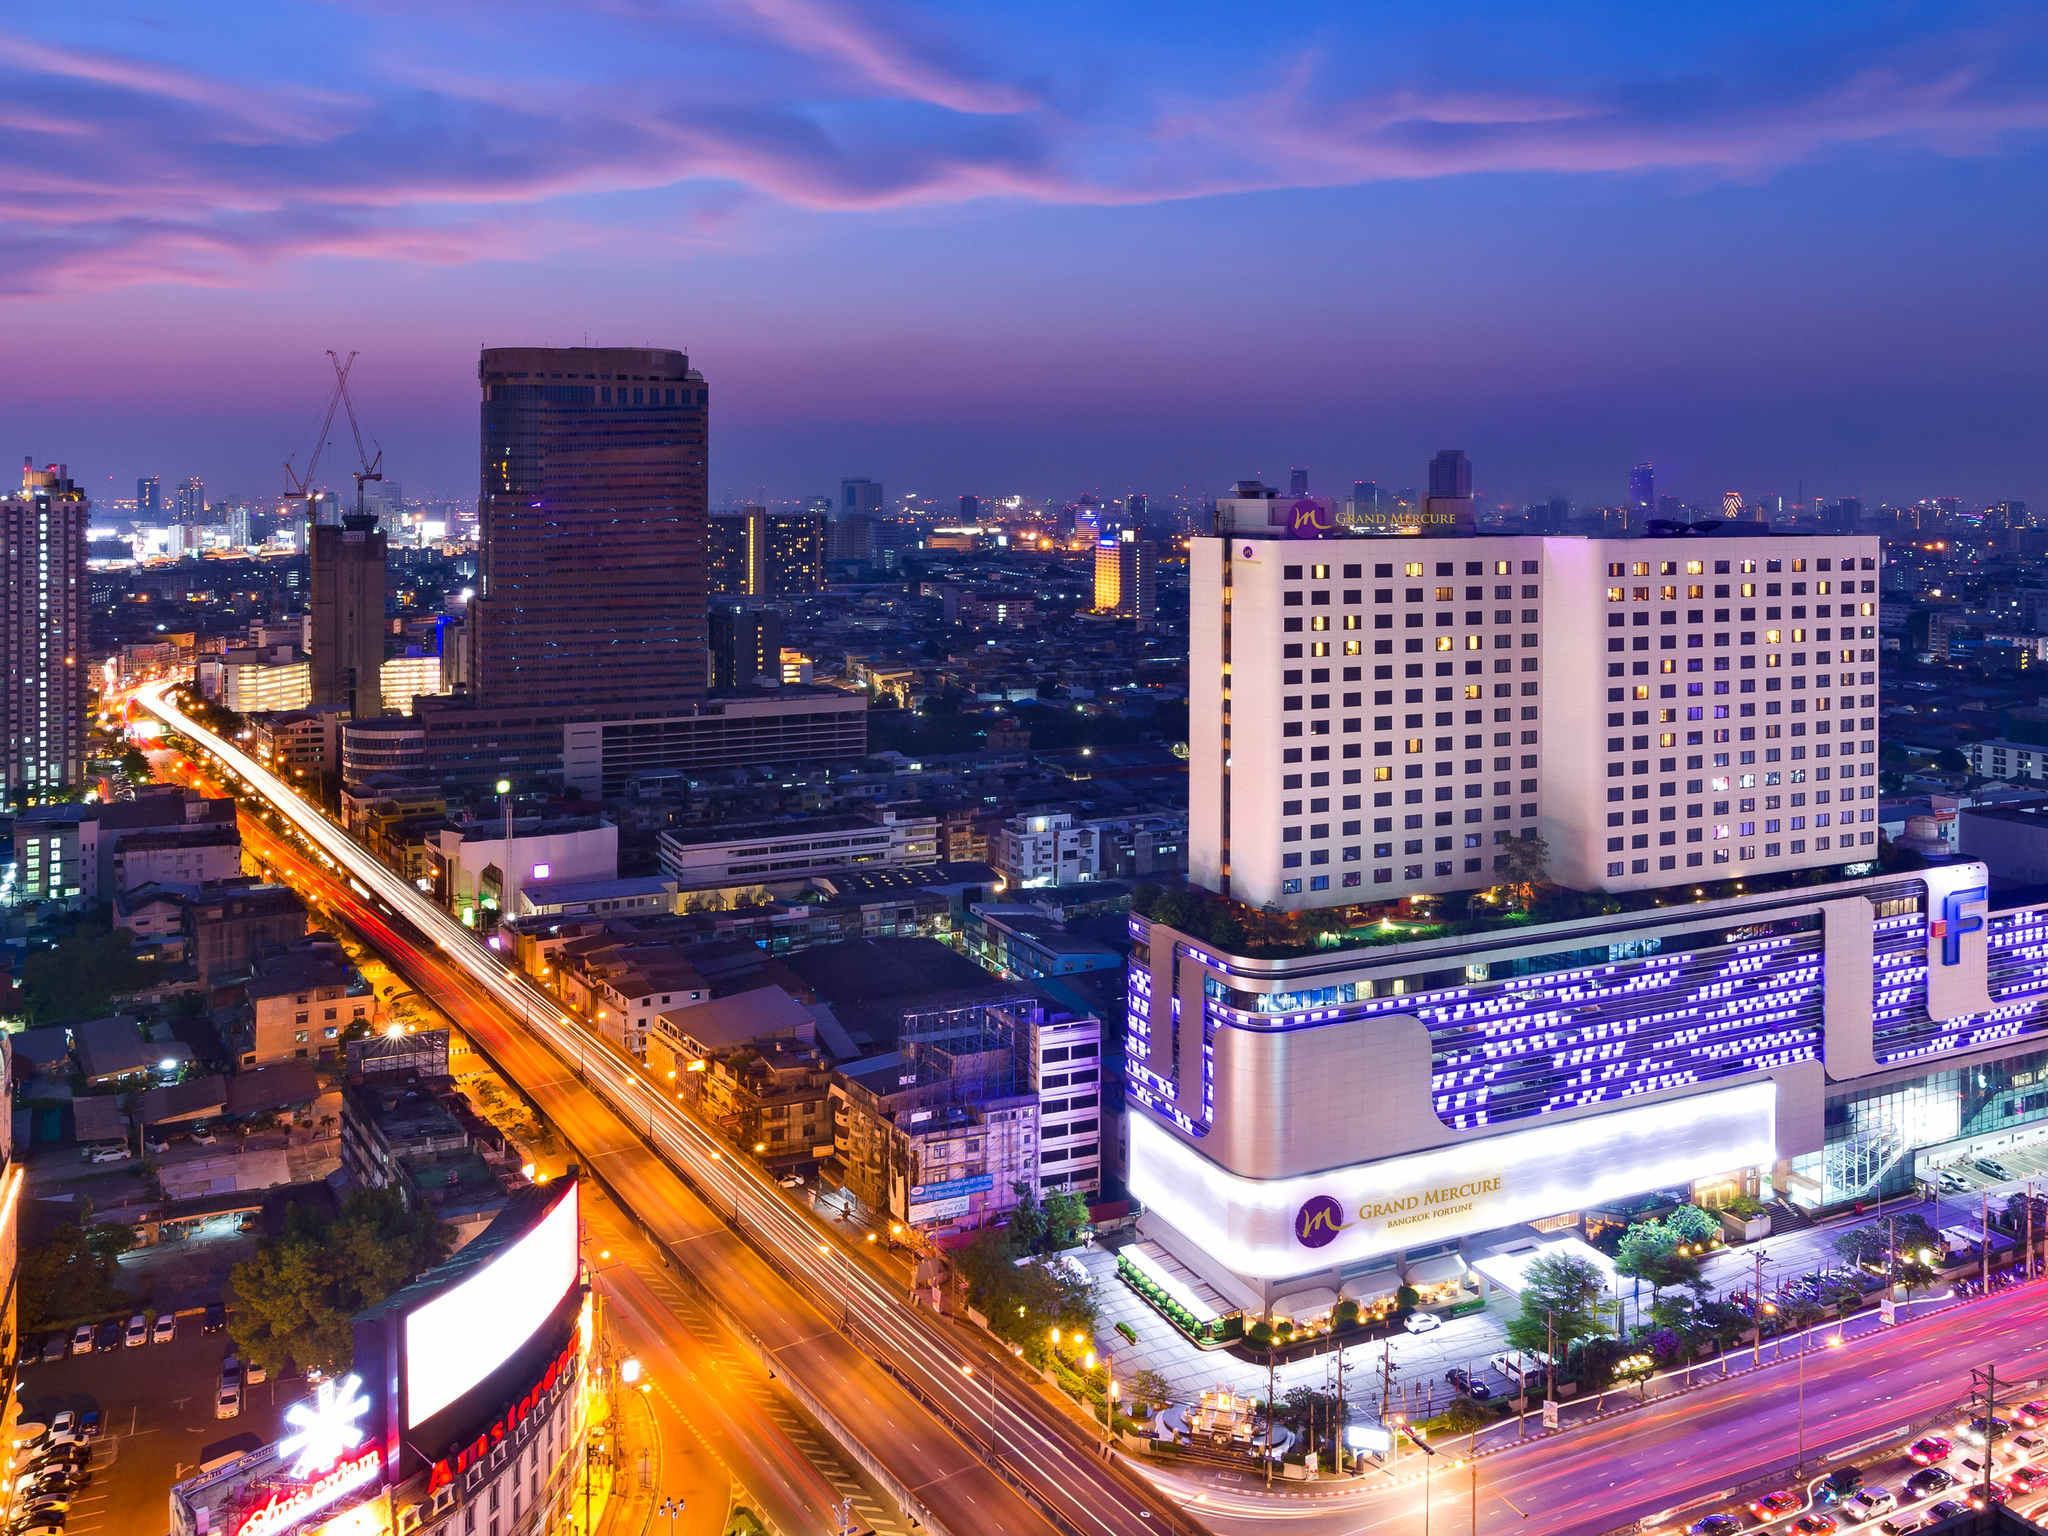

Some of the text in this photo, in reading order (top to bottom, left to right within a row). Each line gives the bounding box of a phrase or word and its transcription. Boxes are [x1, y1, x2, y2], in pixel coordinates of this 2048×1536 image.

[1335, 512, 1457, 525] GRAND MERCURE
[1359, 1177, 1501, 1220] GRAND MERCURE
[1387, 1203, 1473, 1228] BANGKOK FORTUNE
[237, 1450, 380, 1536] Amserdam
